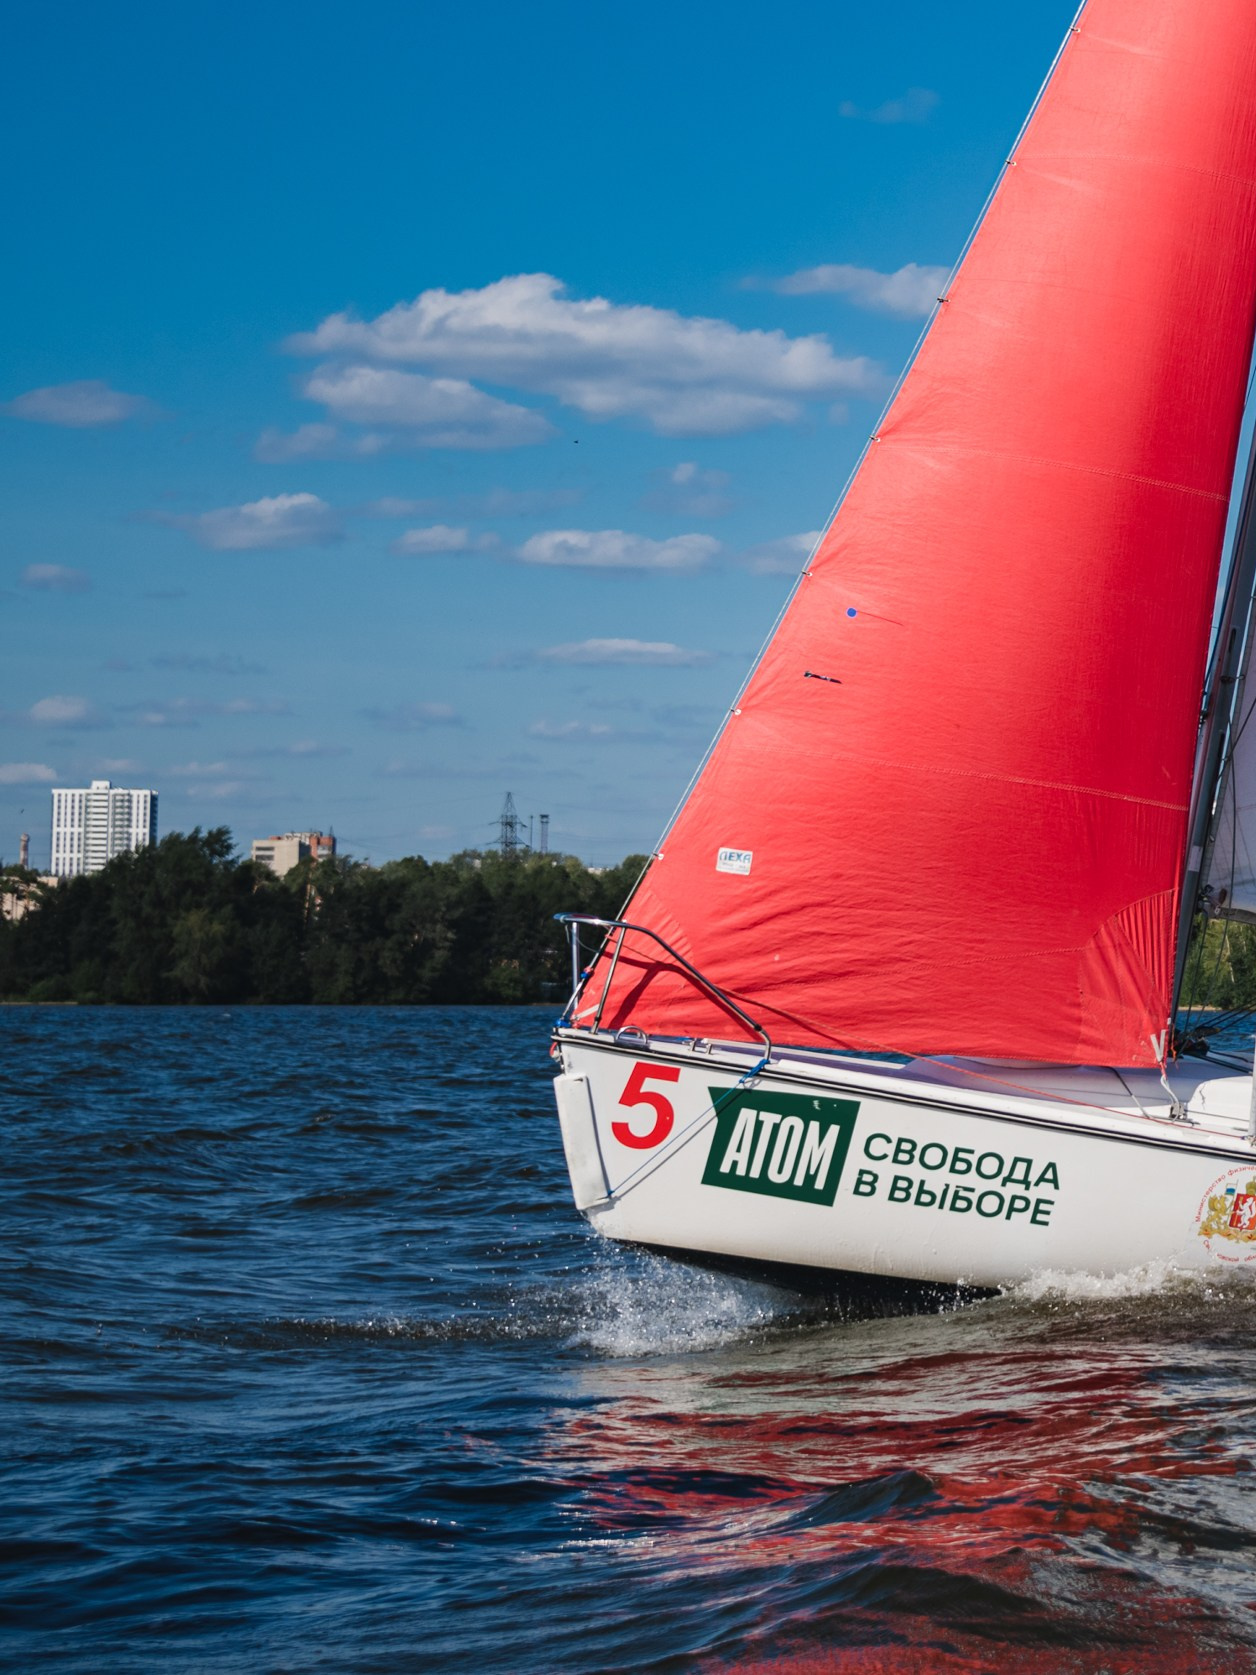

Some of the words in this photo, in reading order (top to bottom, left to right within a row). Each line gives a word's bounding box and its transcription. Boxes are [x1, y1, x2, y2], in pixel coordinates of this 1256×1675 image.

[611, 1061, 681, 1150] 5
[720, 1108, 841, 1191] АТОМ
[863, 1133, 1061, 1191] СВОБОДА
[853, 1169, 880, 1197] В
[887, 1175, 1055, 1227] ВЫБОРЕ
